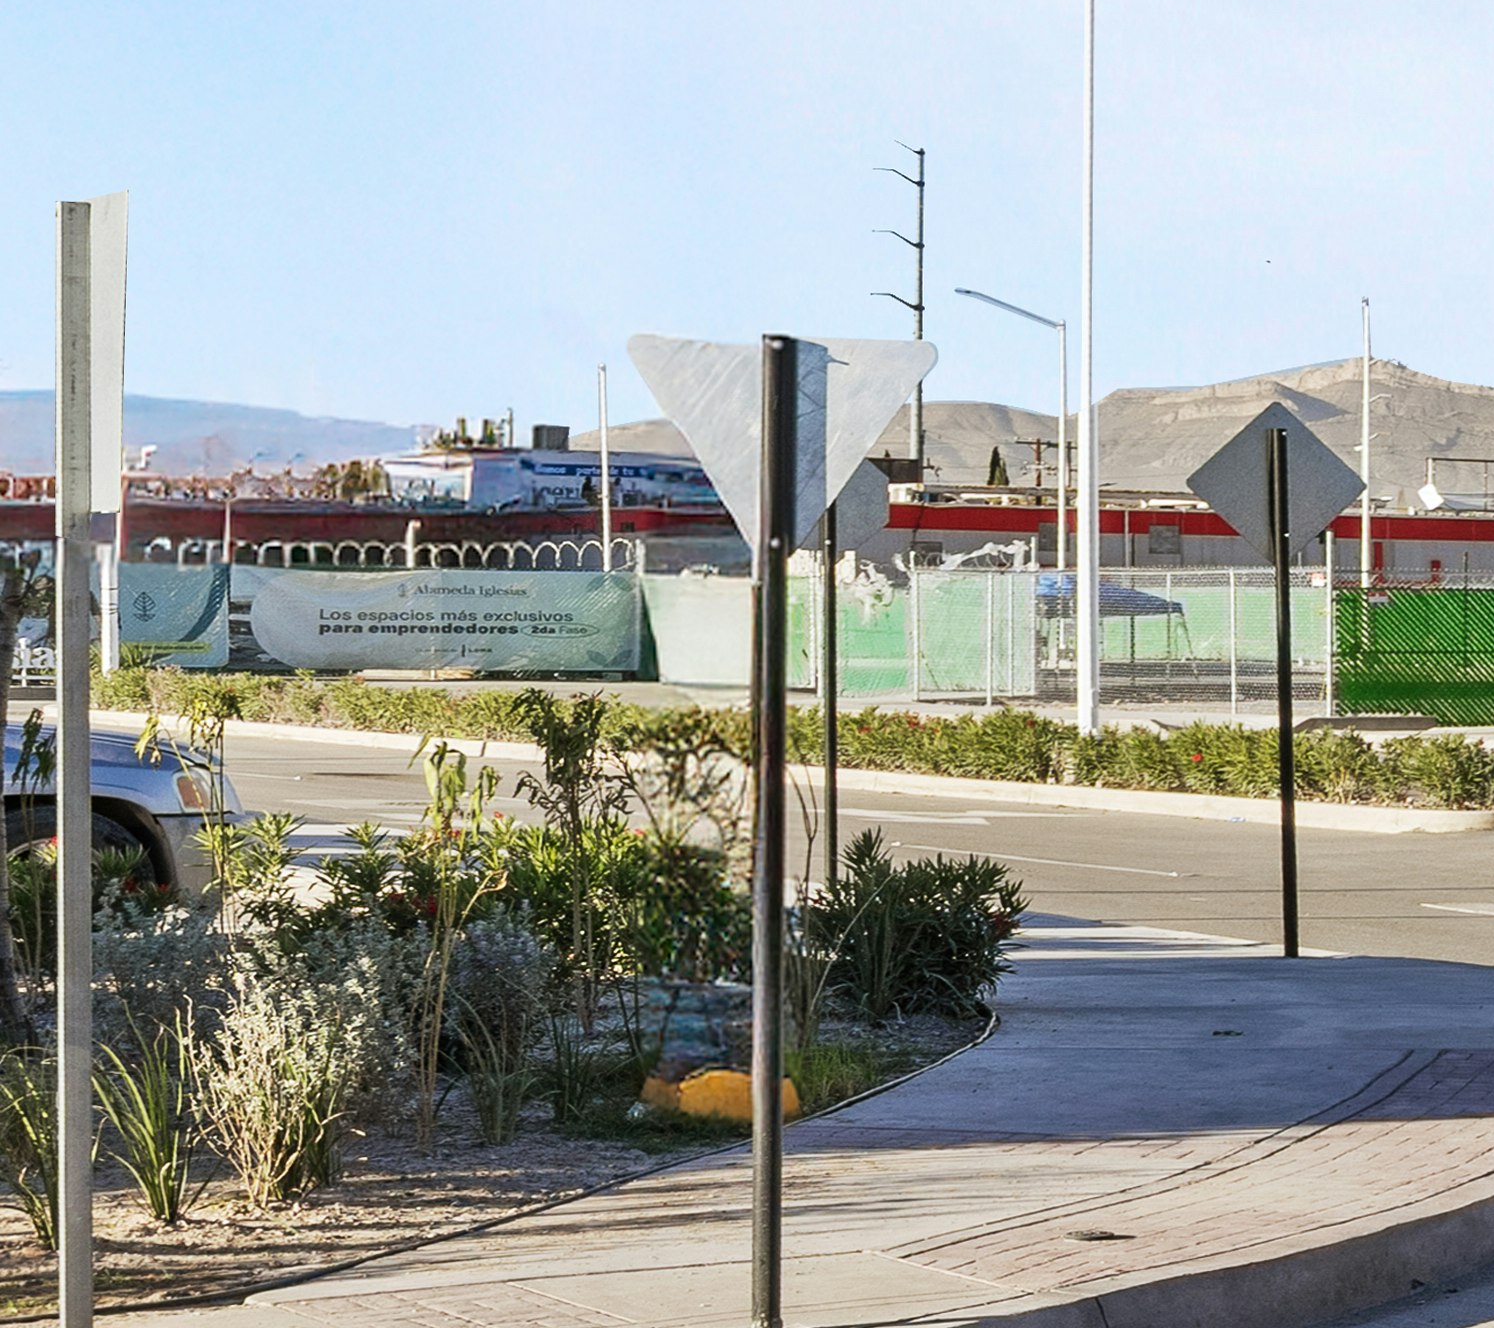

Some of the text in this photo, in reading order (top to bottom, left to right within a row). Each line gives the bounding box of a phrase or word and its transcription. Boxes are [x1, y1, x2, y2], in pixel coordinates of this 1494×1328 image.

[414, 583, 529, 598] Alameda Iglesias
[319, 608, 574, 625] Los espacios más exclusivos
[319, 623, 364, 636] para
[368, 621, 519, 636] emprendedores
[531, 624, 556, 634] 2da
